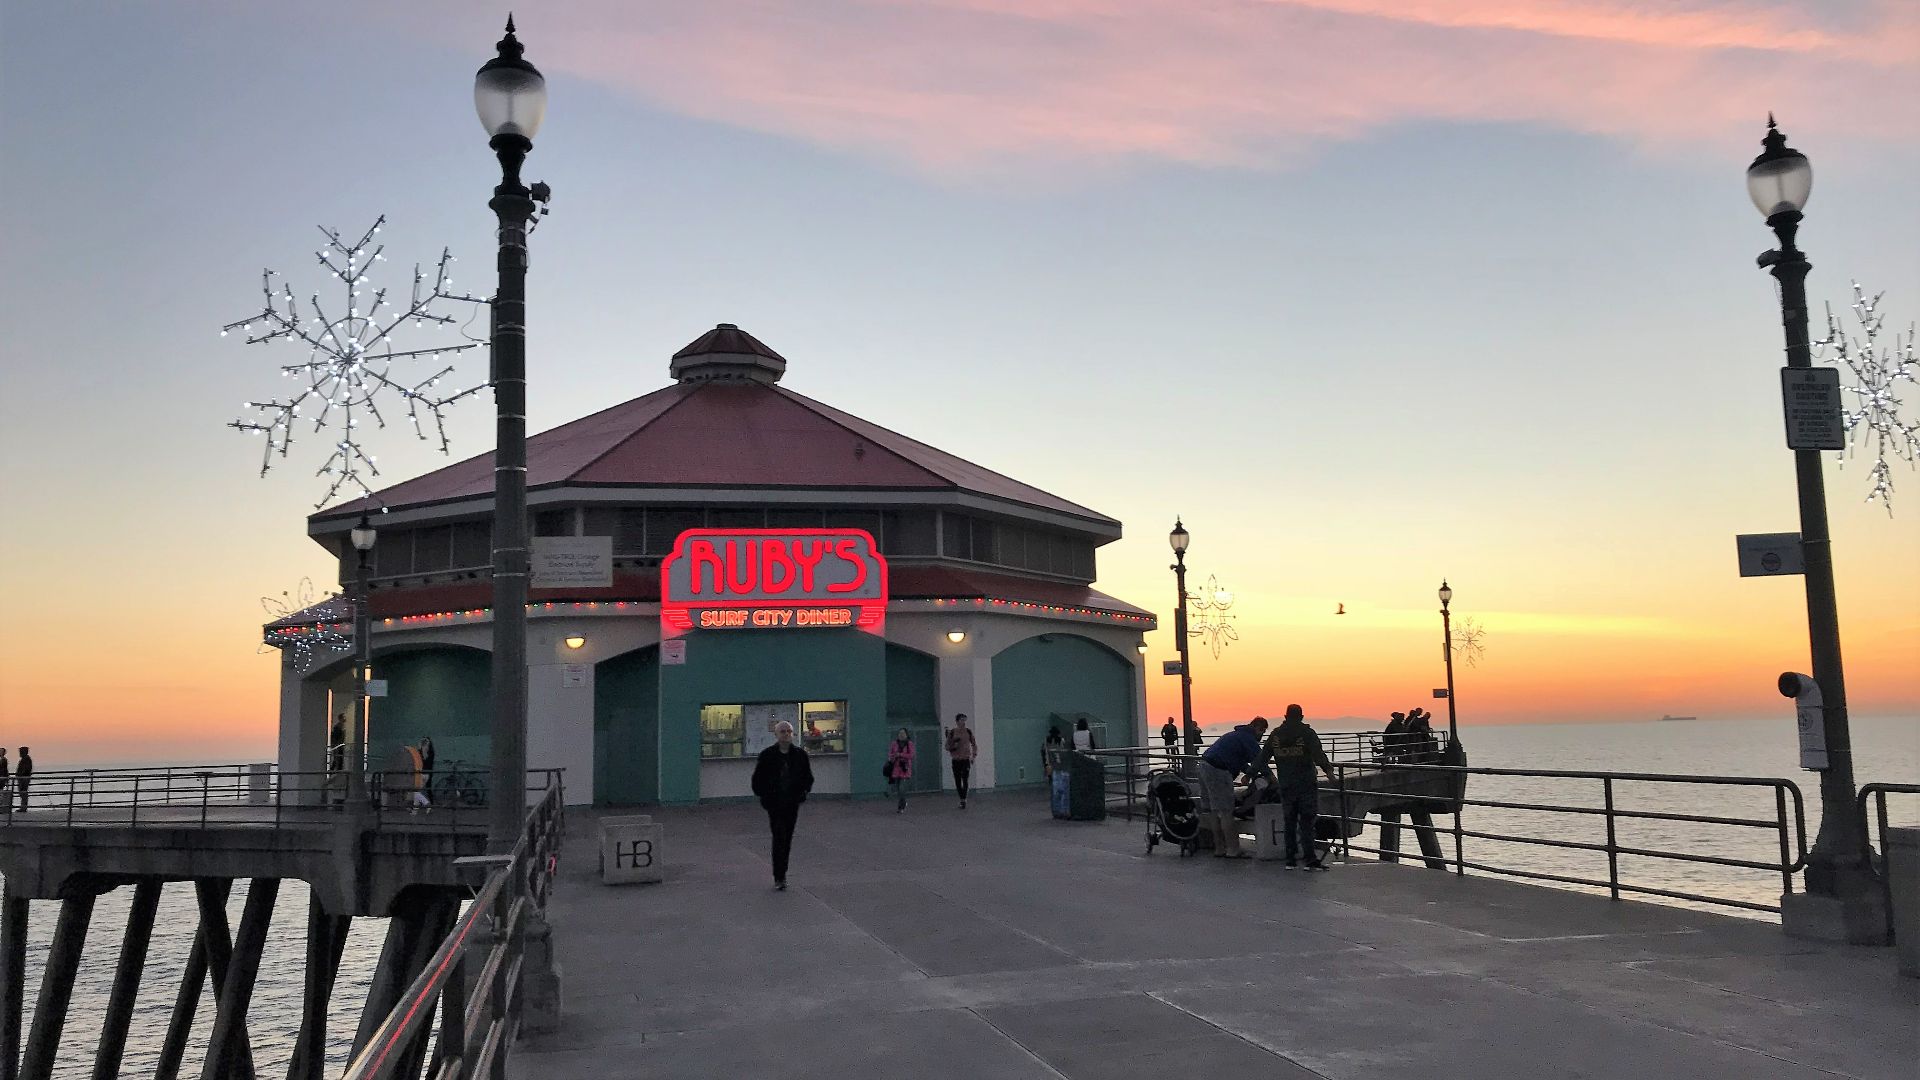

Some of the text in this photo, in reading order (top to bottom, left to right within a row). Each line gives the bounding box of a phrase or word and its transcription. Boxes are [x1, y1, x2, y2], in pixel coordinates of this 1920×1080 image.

[690, 539, 867, 595] RUBY'S
[700, 608, 852, 627] SURF CITY DINER
[616, 840, 653, 869] HB
